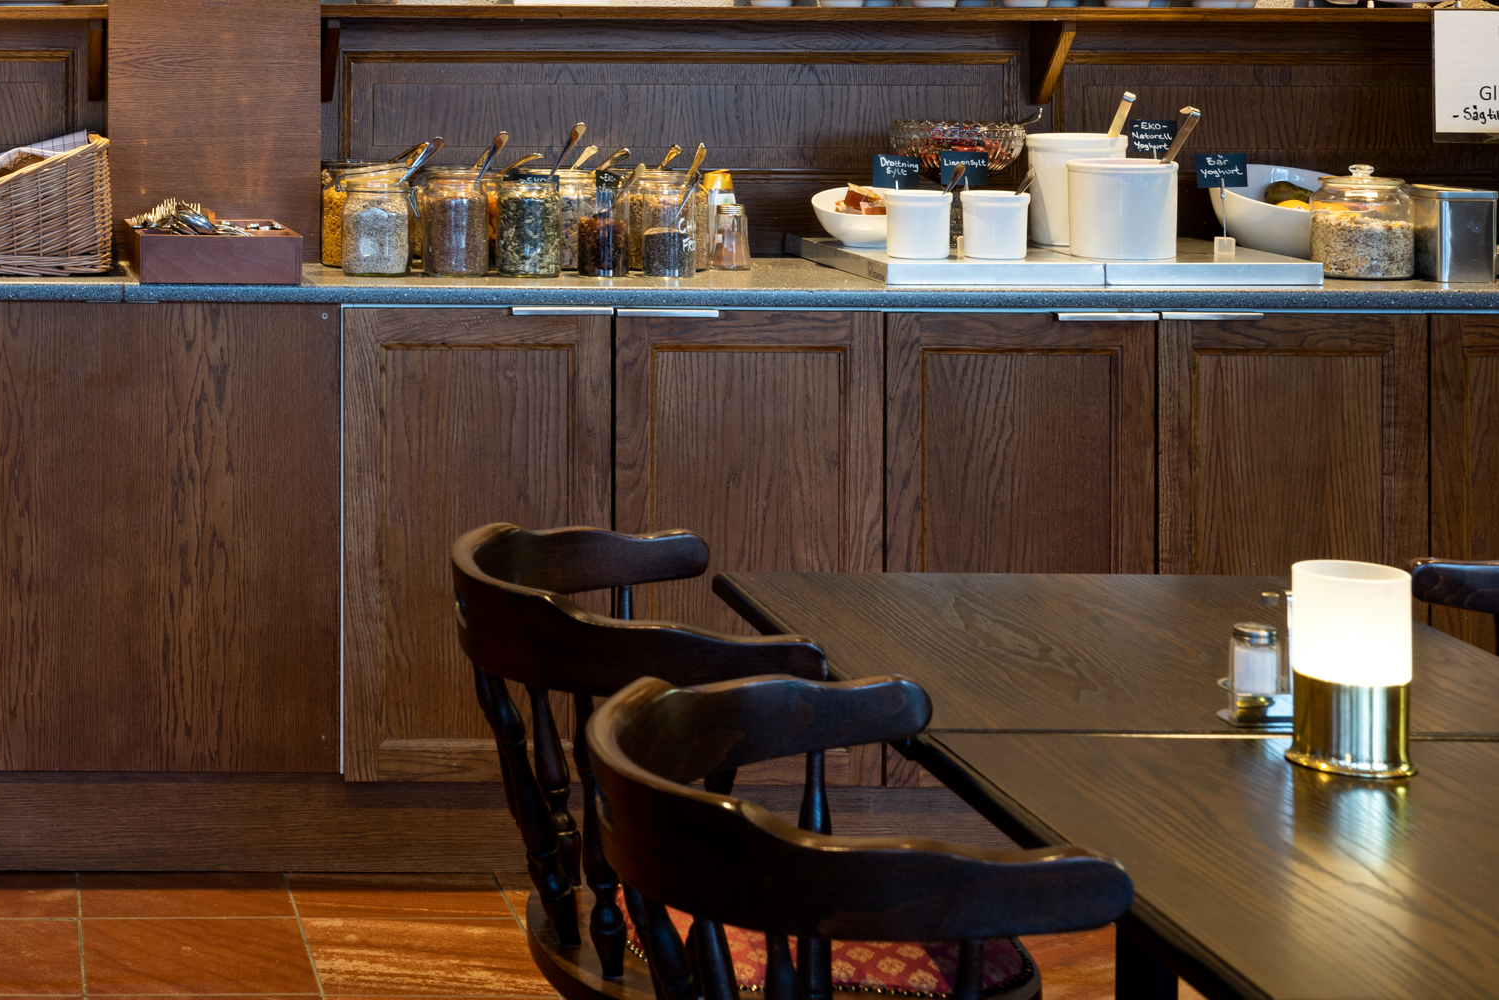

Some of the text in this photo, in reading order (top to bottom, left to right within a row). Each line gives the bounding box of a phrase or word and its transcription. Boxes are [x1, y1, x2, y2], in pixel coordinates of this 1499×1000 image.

[1131, 131, 1173, 140] Naturell
[880, 156, 919, 173] Drottning
[1205, 154, 1229, 166] Bär
